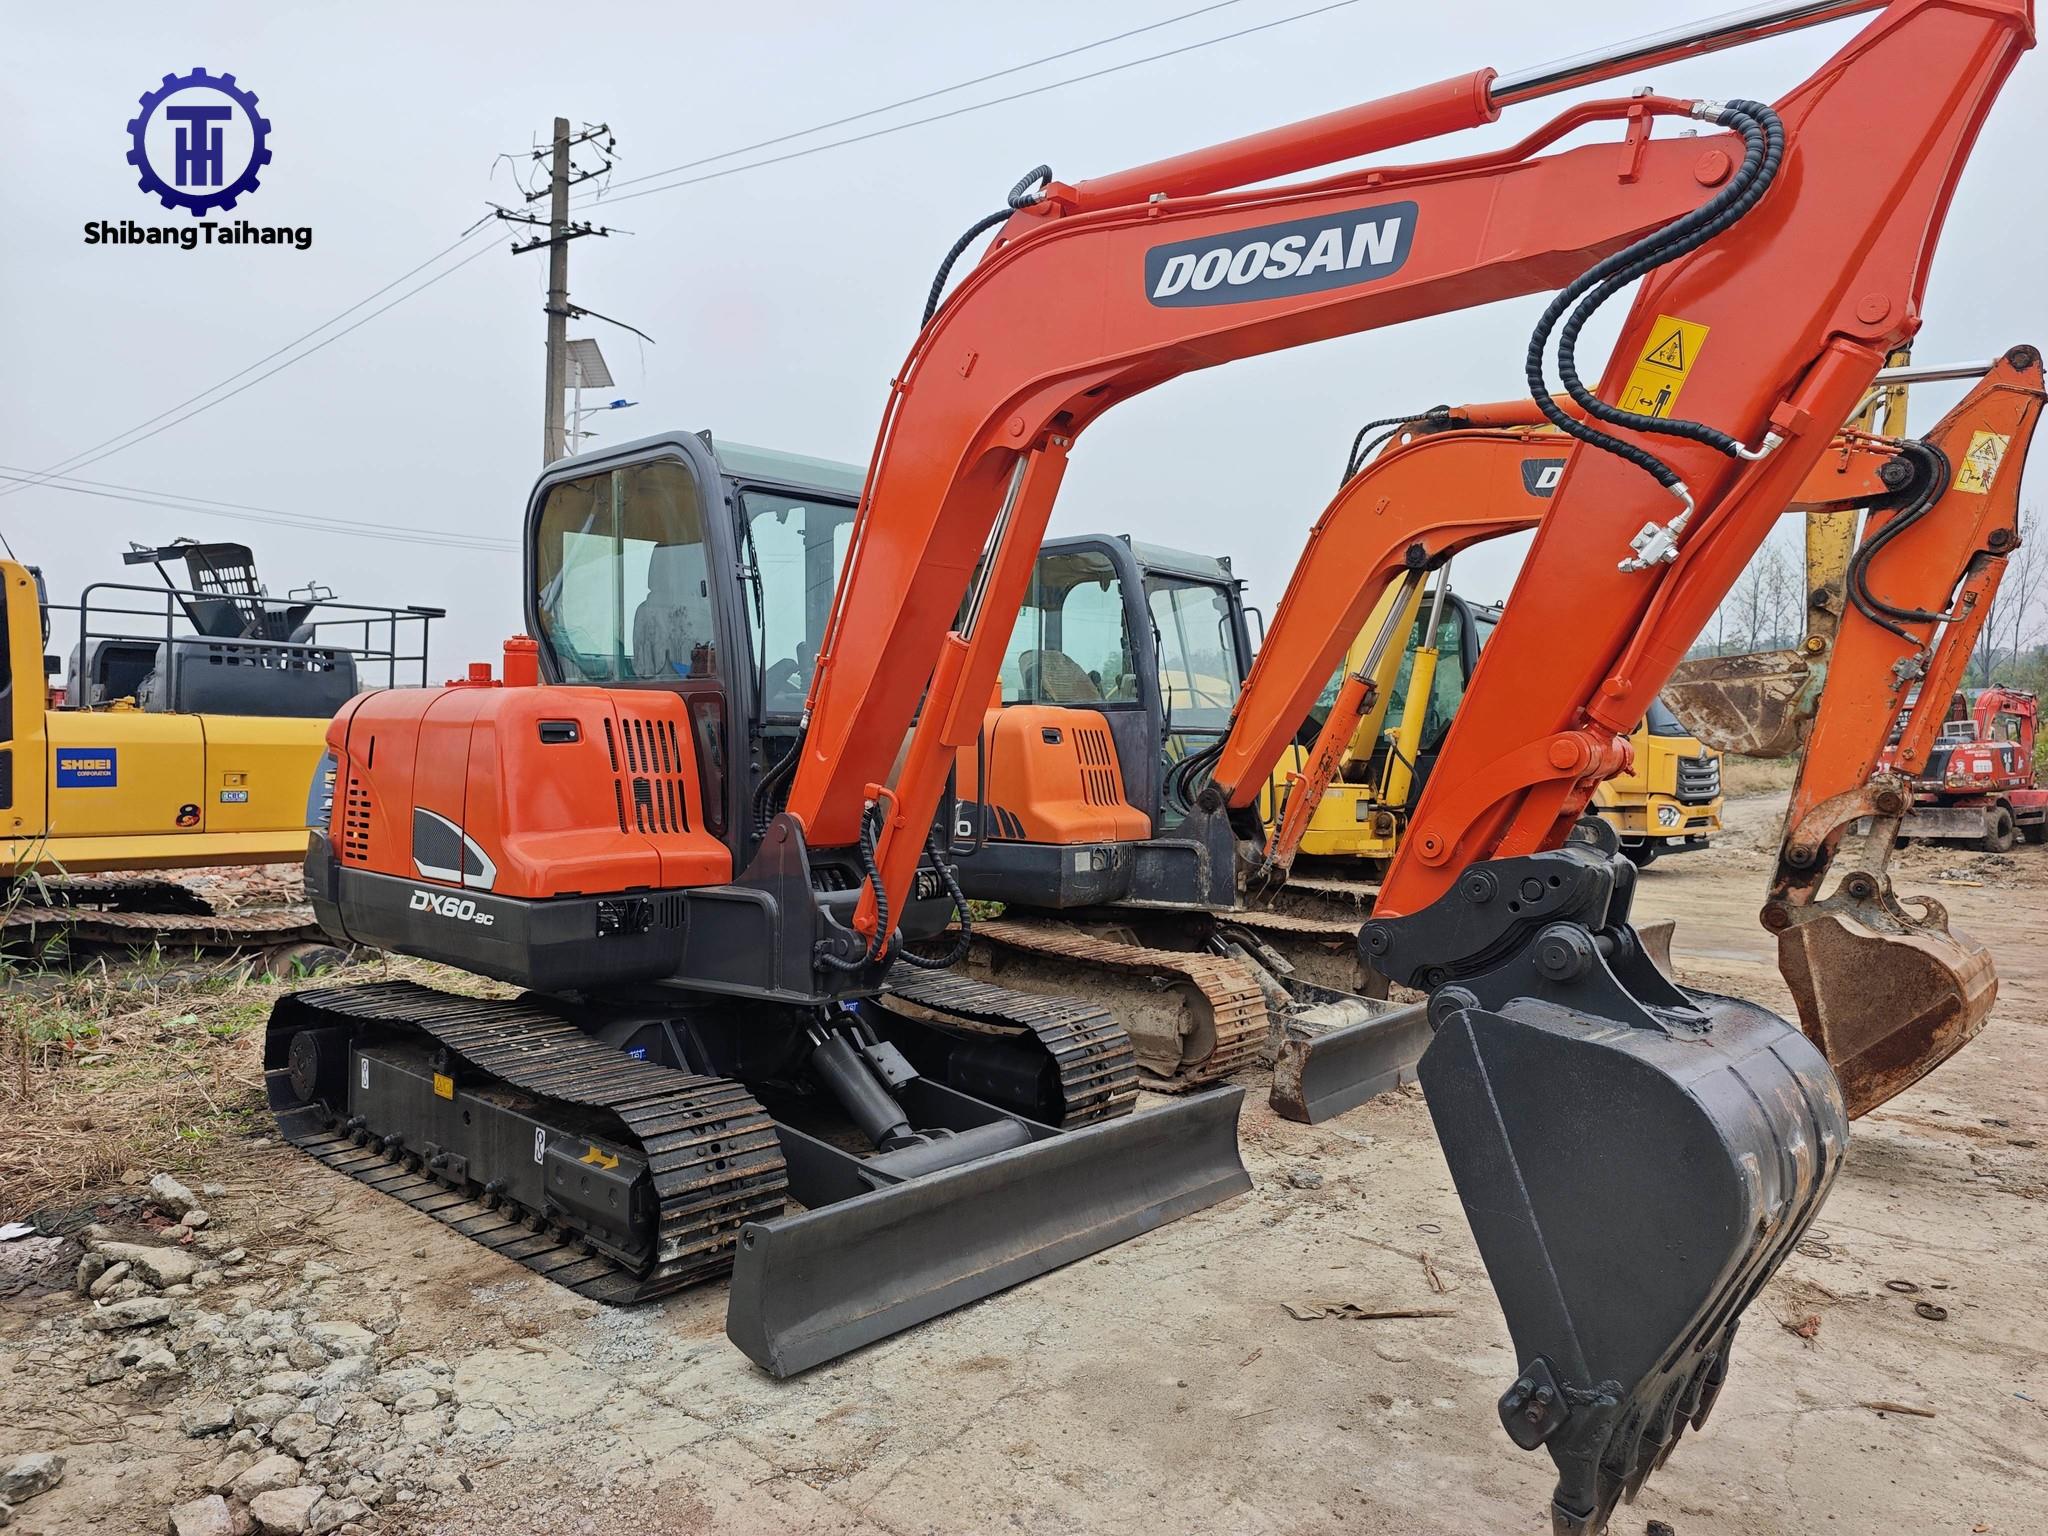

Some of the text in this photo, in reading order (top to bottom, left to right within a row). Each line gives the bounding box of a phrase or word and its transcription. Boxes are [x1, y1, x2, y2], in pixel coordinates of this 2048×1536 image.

[1153, 217, 1401, 298] DOOSAN
[61, 759, 111, 770] SHOEI
[409, 889, 495, 926] DX60-9C
